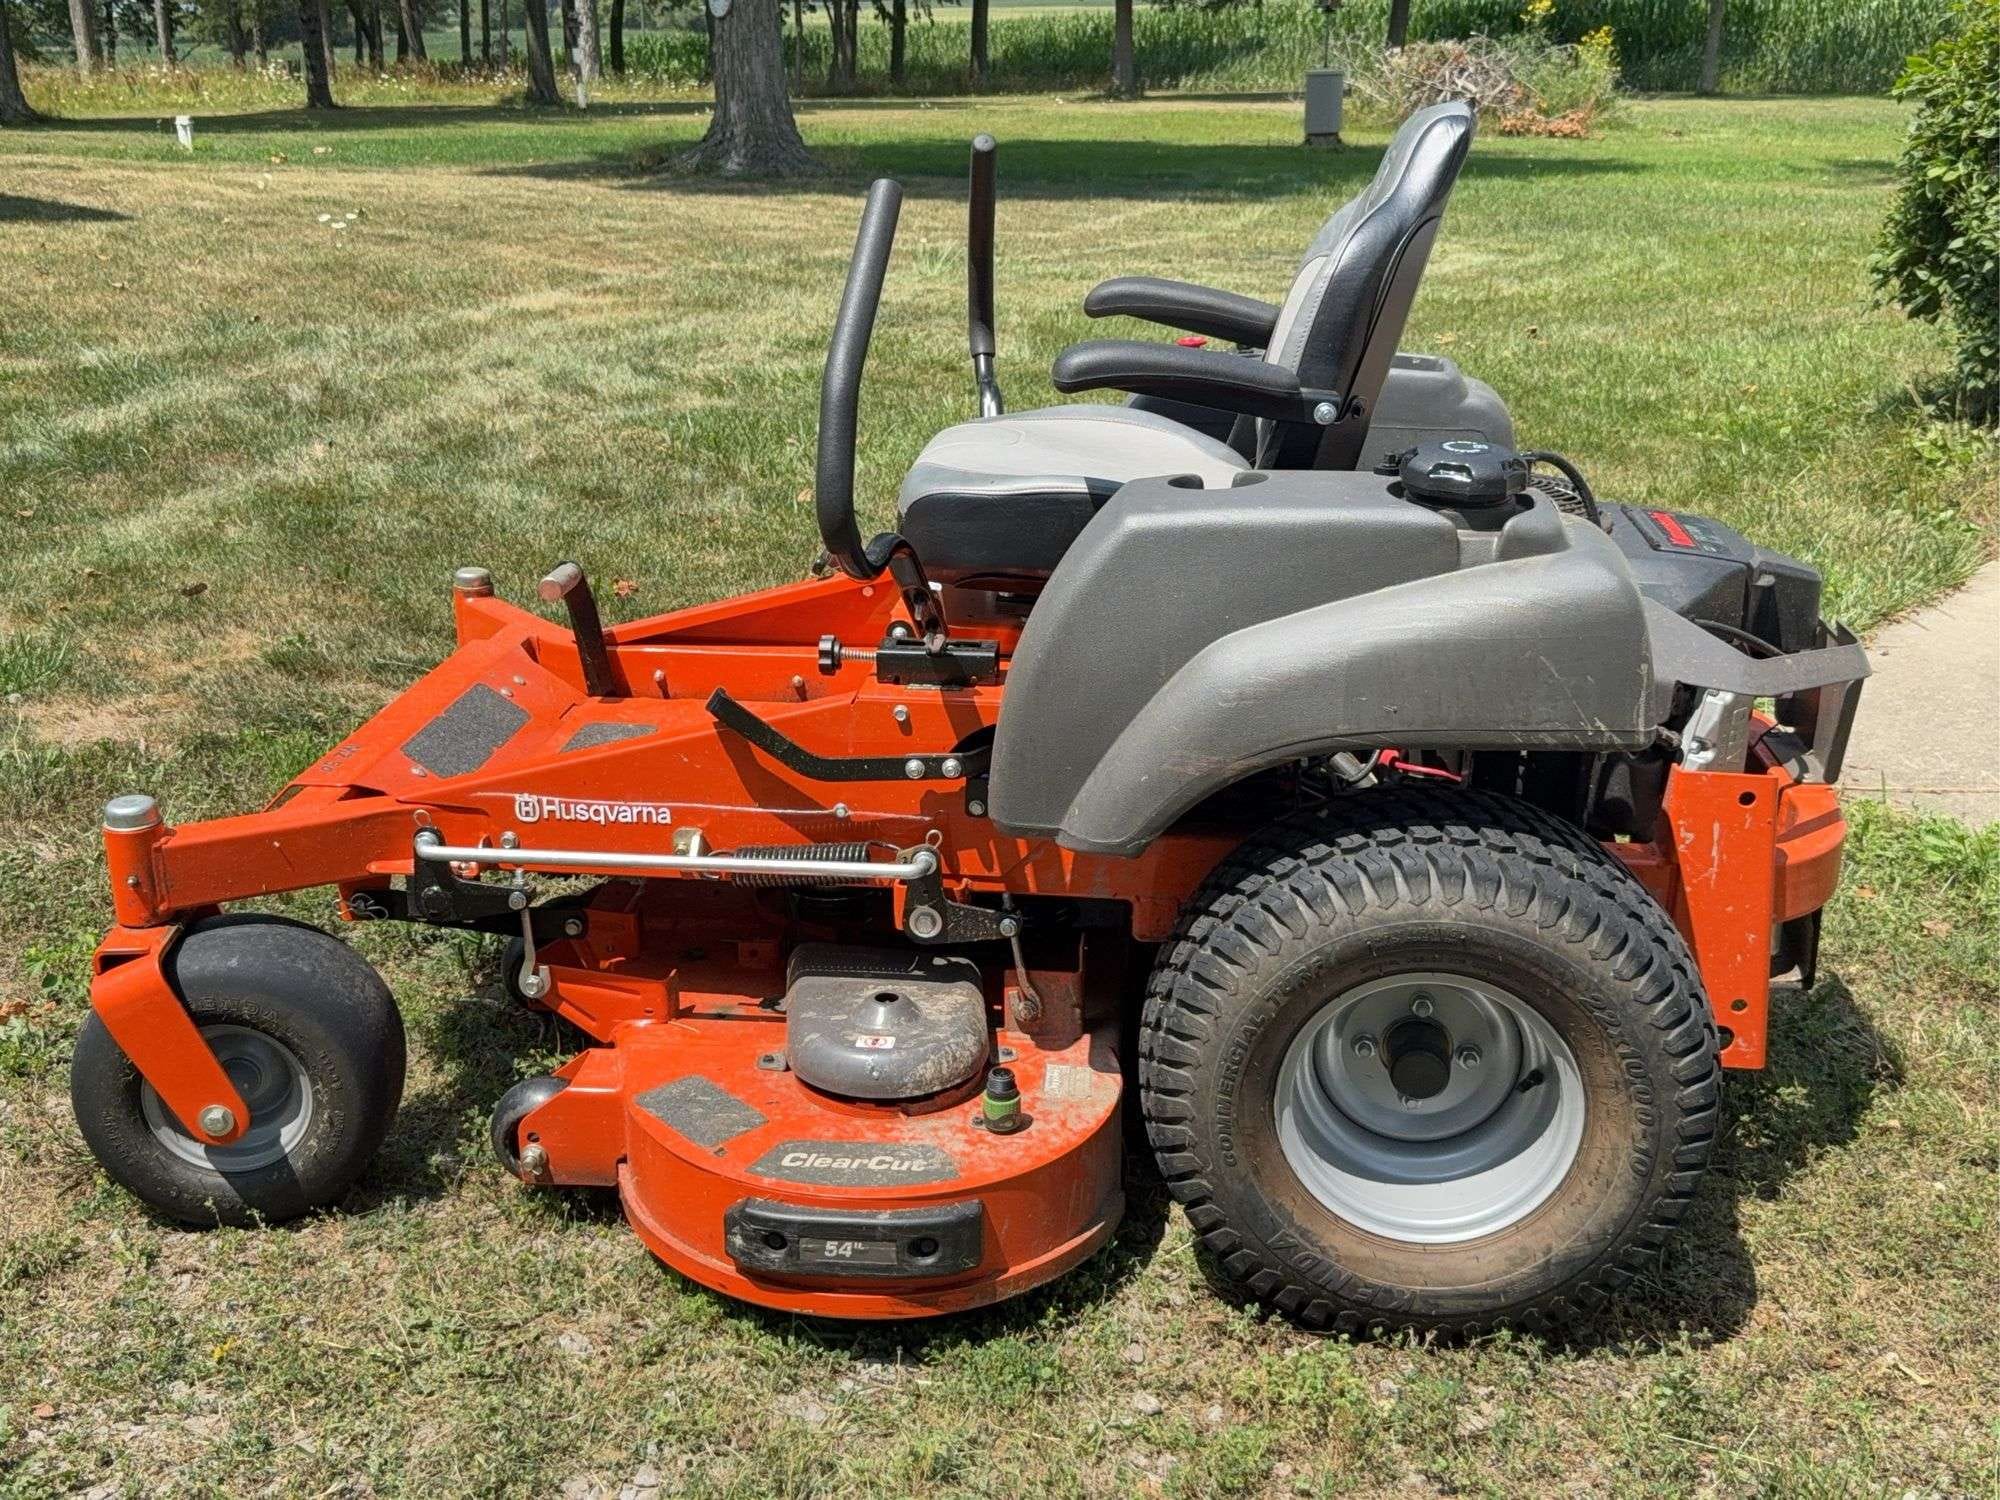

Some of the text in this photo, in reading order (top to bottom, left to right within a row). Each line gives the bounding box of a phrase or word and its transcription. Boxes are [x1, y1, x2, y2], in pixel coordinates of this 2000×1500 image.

[542, 797, 672, 825] Husqvarna
[1216, 1013, 1266, 1168] COMMERCIAL
[781, 1152, 926, 1172] ClearCut
